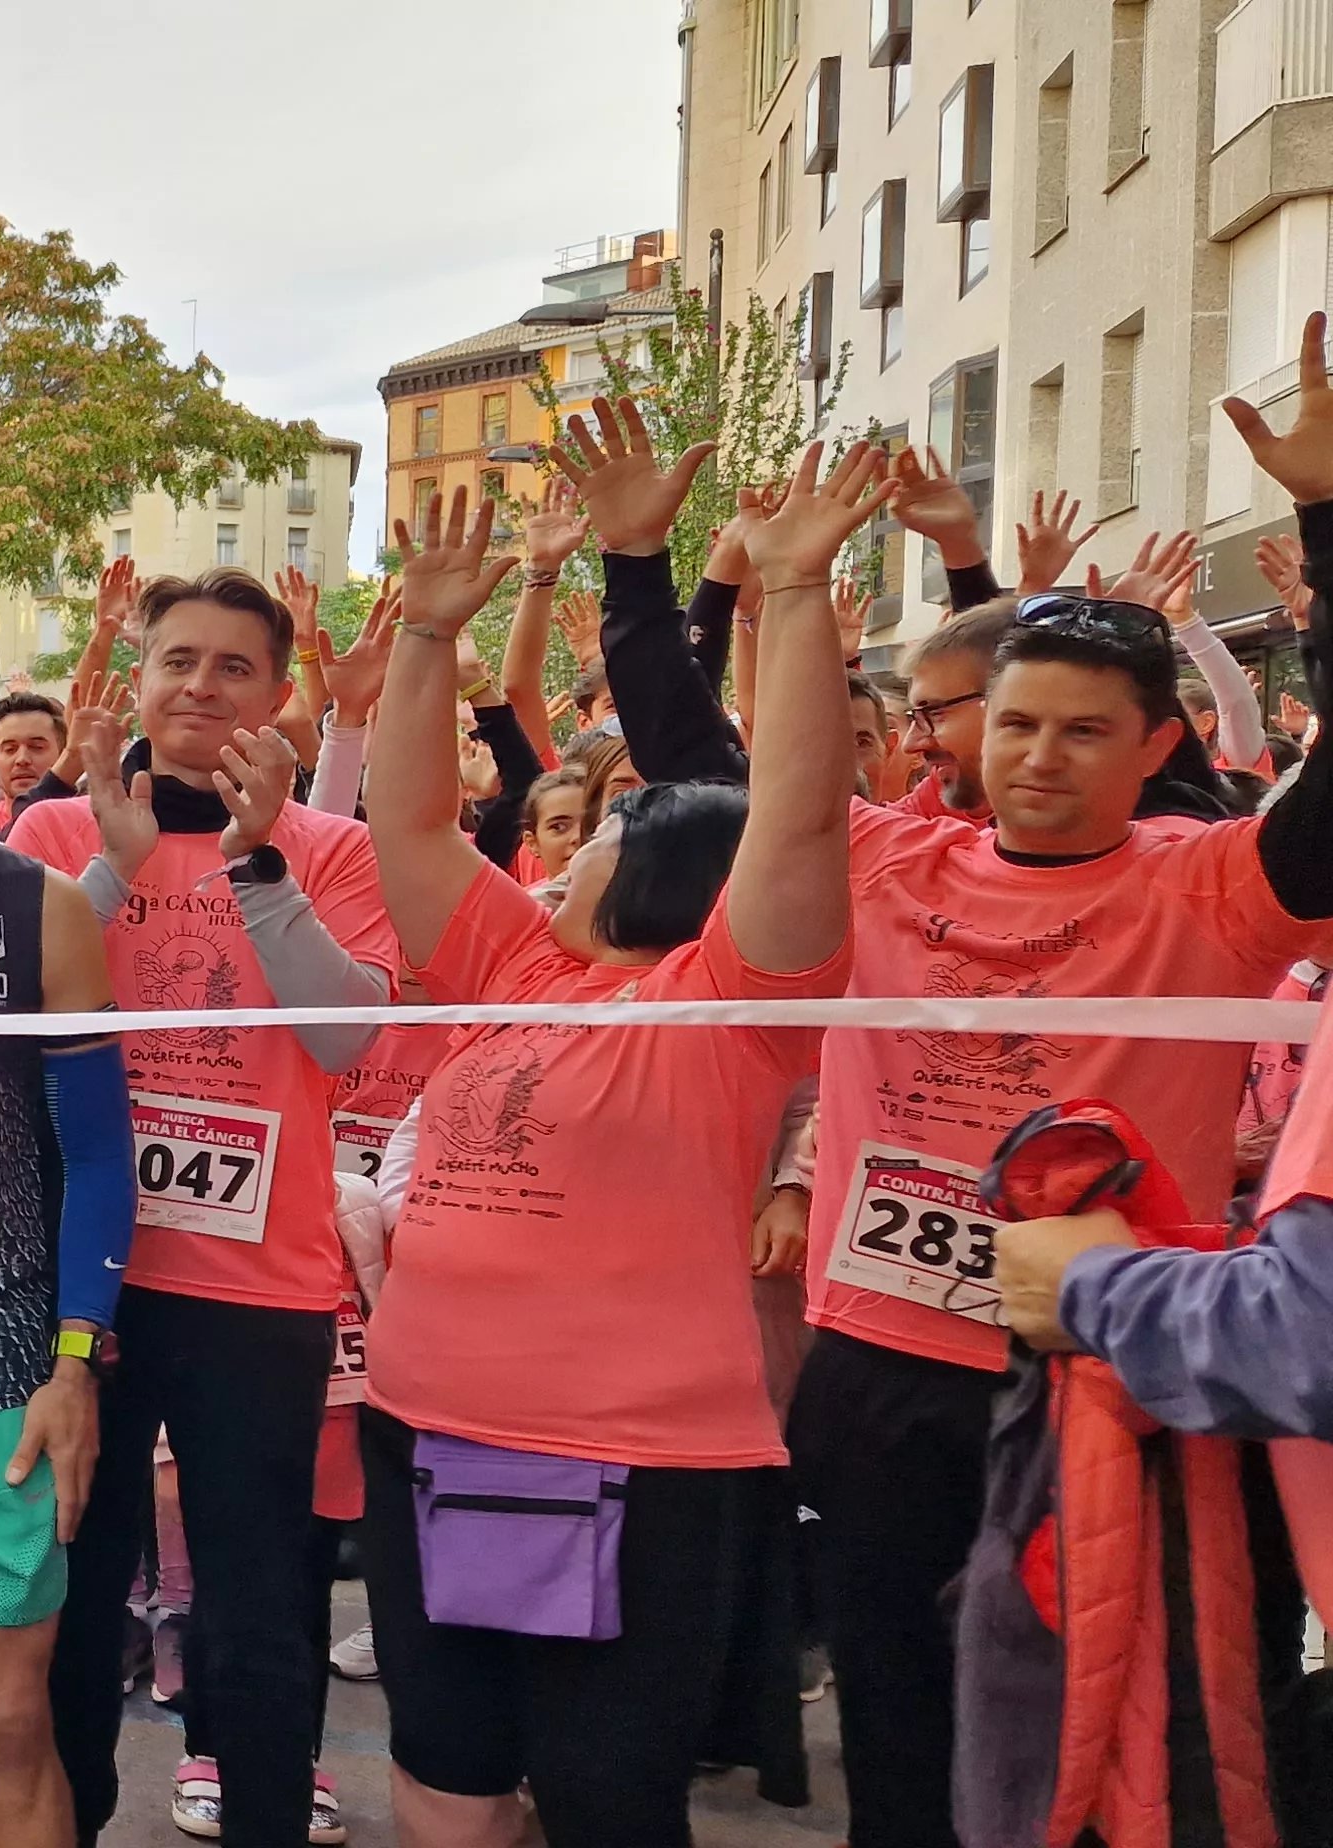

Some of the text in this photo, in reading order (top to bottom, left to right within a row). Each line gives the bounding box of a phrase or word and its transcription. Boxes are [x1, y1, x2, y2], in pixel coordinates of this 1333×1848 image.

[1190, 551, 1215, 595] TE
[127, 893, 242, 925] 9ª CÁNCE
[208, 914, 246, 927] HUES
[1022, 936, 1098, 953] HUESCA
[196, 1055, 243, 1070] MUCHO
[990, 1082, 1052, 1099] MUCHO
[160, 1111, 206, 1127] HUESCA
[132, 1119, 257, 1149] NTRA EL CÁNCER
[339, 1131, 379, 1147] CONTRA
[489, 1162, 539, 1177] MUCHO
[877, 1173, 982, 1212] CONTRA EL
[946, 1176, 981, 1196] HUES
[857, 1198, 998, 1280] 283
[337, 1313, 361, 1325] CER
